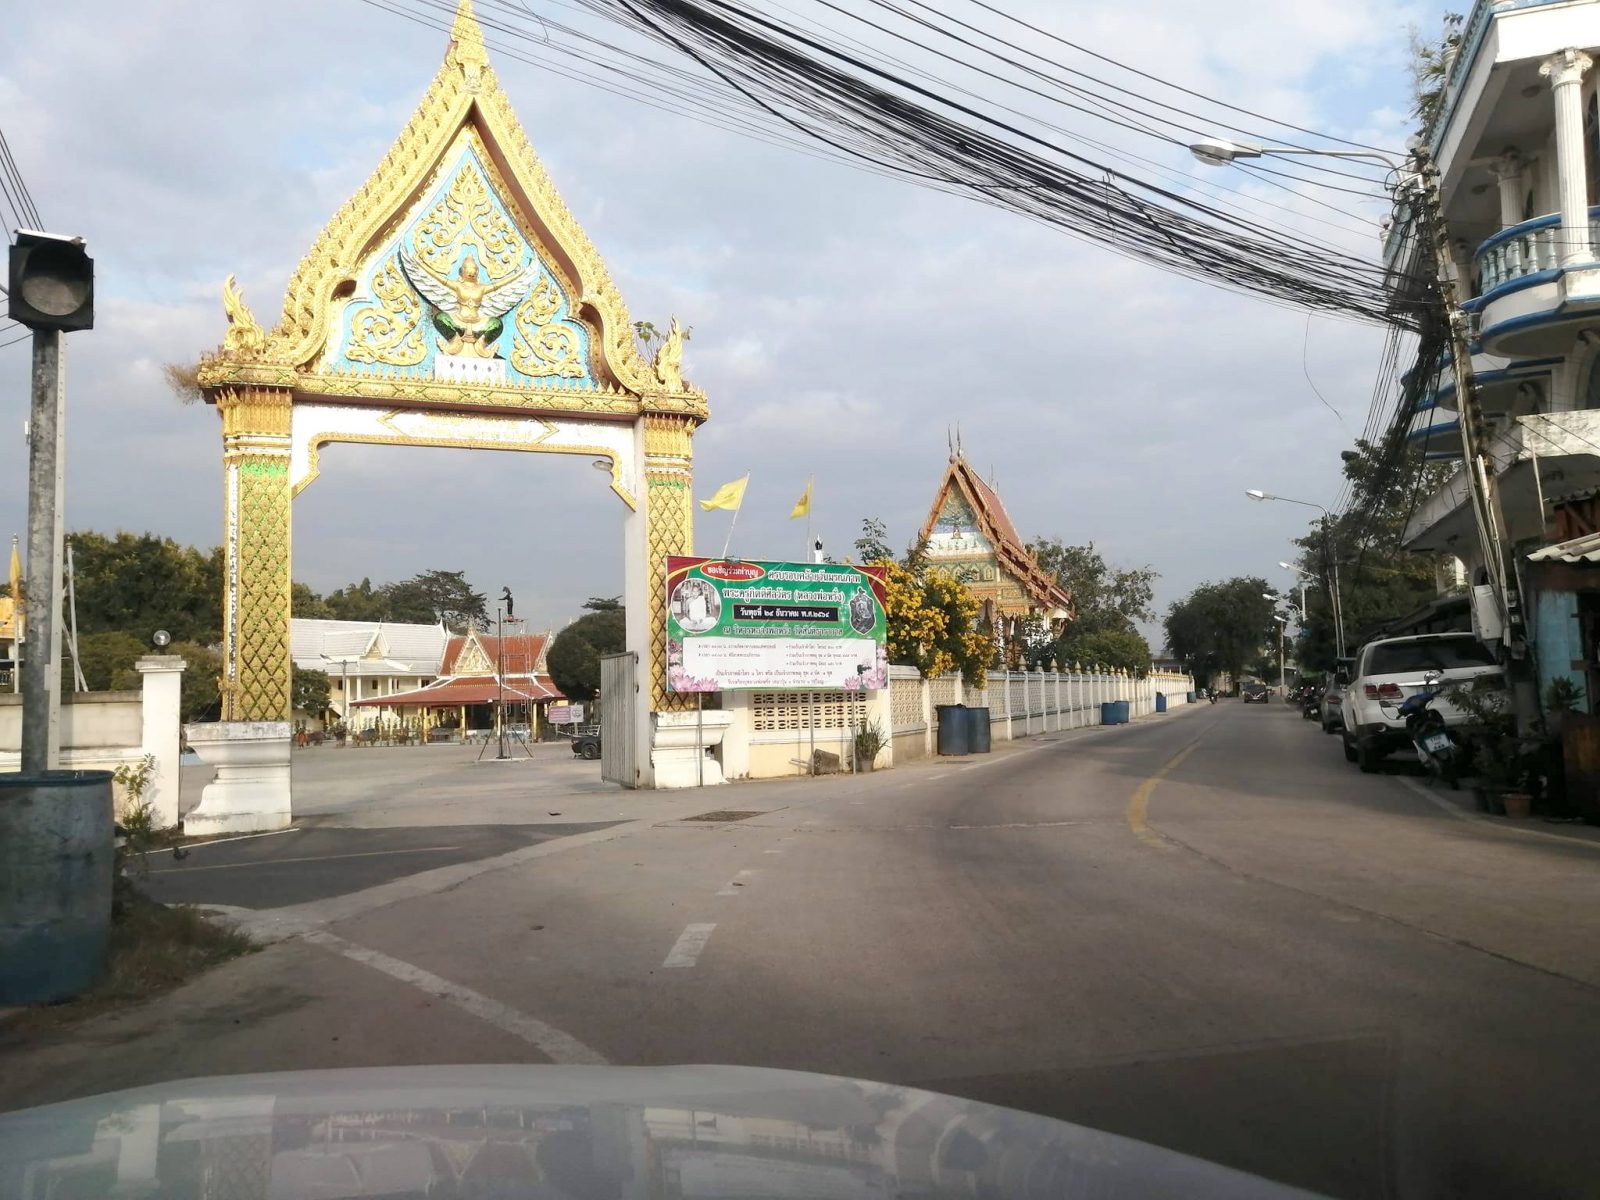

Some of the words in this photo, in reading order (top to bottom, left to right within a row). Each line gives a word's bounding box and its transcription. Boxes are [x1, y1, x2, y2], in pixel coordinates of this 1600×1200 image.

[740, 606, 762, 619] วันพุธที่
[775, 608, 799, 617] ธันวาคม
